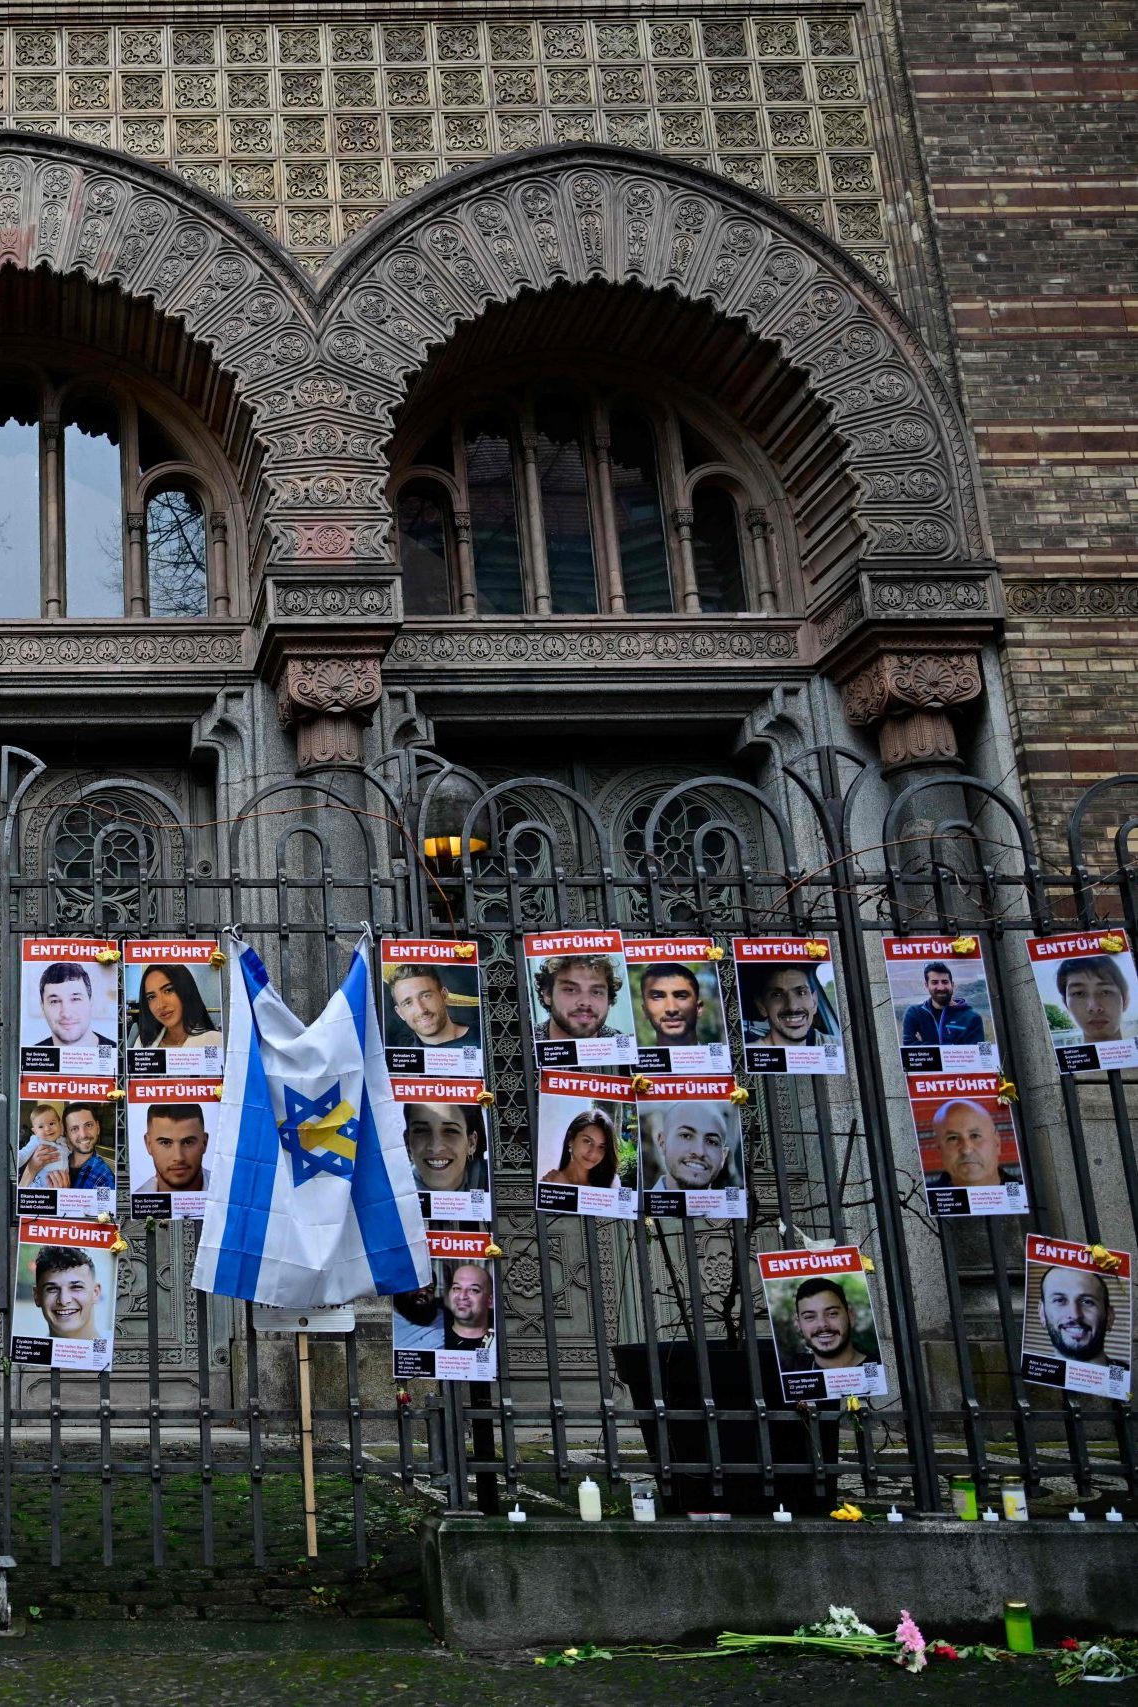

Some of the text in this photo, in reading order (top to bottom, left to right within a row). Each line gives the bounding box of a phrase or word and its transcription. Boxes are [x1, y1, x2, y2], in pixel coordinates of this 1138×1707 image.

[533, 936, 613, 950] ENTFÜHRT
[892, 943, 952, 955] ENTFÜH
[132, 946, 211, 958] ENTFÜHRT
[625, 945, 705, 957] ENTFÜHRT
[28, 1081, 108, 1095] ENTFÜHRT
[136, 1084, 216, 1097] ENTFÜHRT
[395, 1084, 477, 1097] ENTFÜHRT
[549, 1077, 631, 1095] ENTFÜHRT
[916, 1078, 996, 1093] ENTFÜHRT
[28, 1225, 110, 1243] ENTFÜHRT
[768, 1254, 852, 1272] ENTFÜHRT
